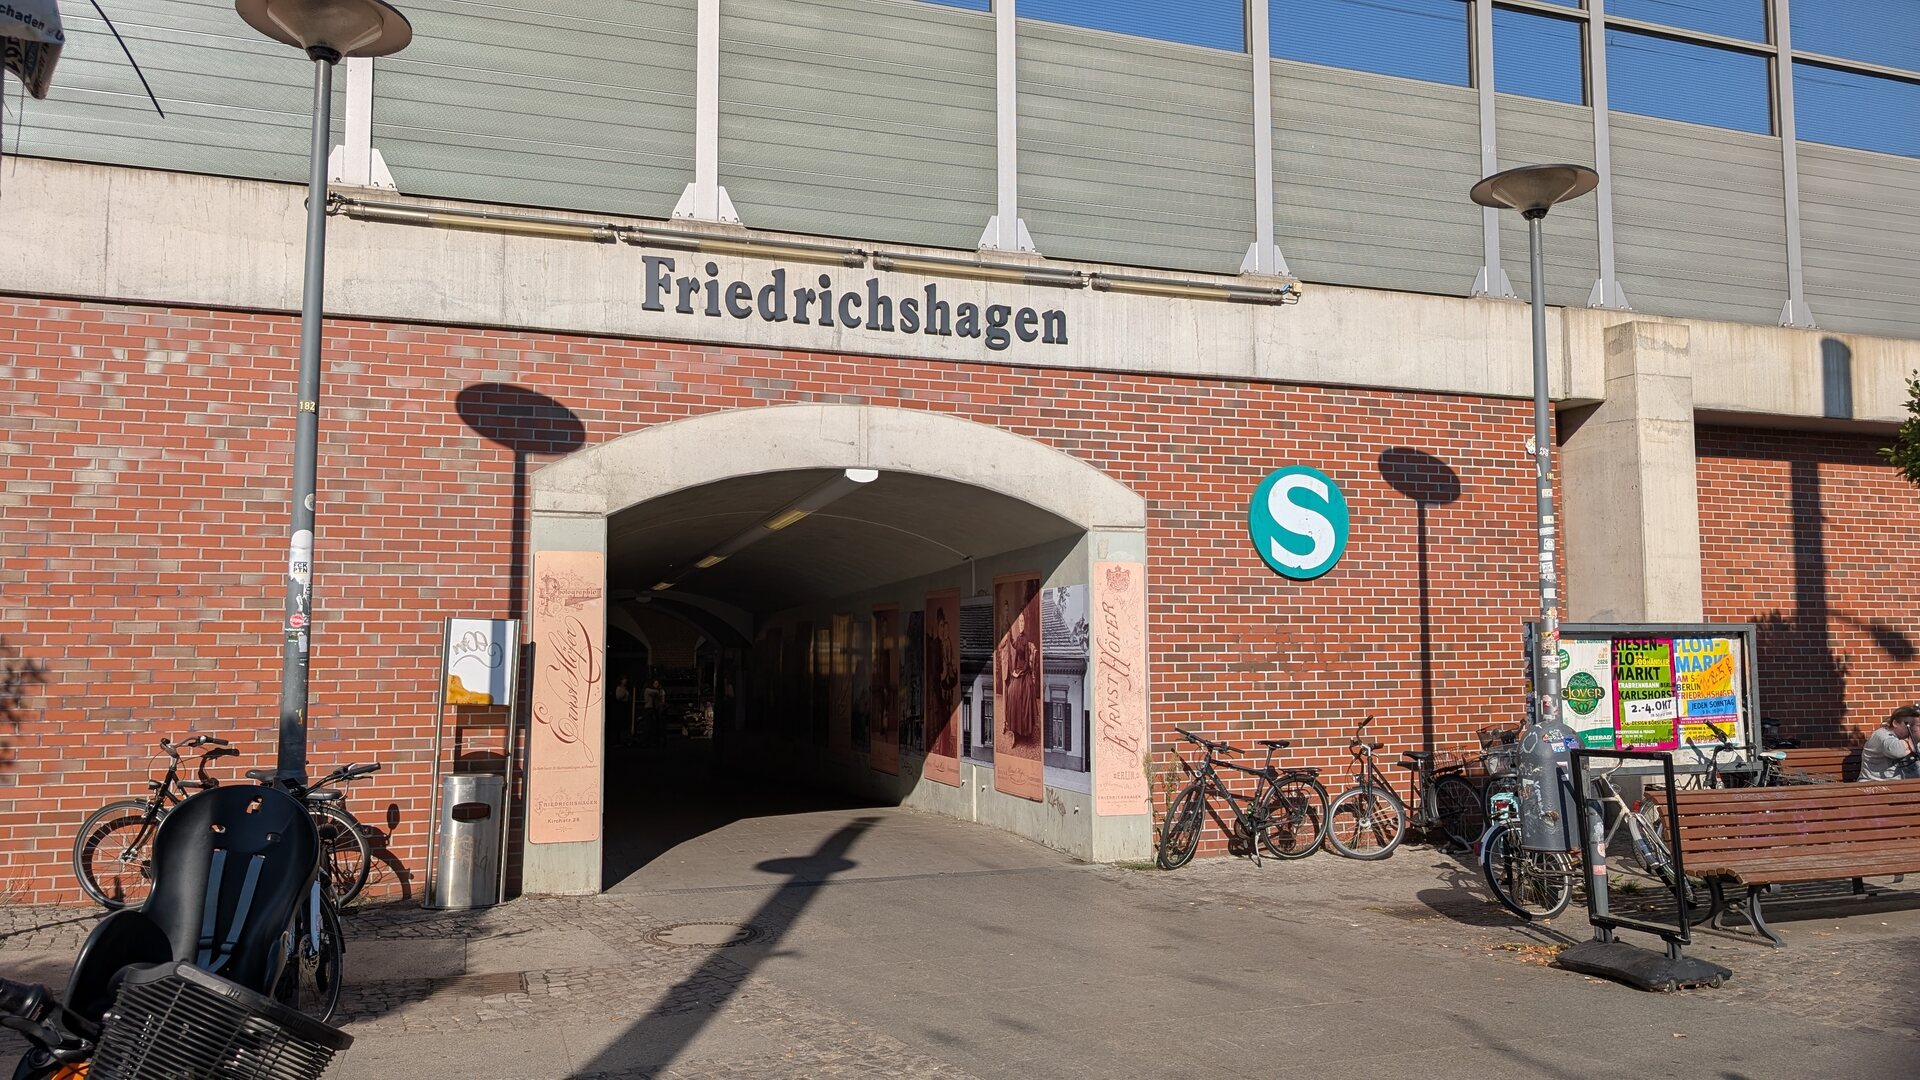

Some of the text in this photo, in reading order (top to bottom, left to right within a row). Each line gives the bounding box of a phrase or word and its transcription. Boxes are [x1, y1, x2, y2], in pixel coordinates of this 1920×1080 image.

[641, 255, 1069, 351] Friedrichshagen
[300, 401, 316, 411] 182
[1268, 474, 1335, 570] S
[1097, 601, 1131, 691] HÖFER
[1673, 639, 1720, 653] FLOH-
[1613, 667, 1661, 680] MARKT
[1676, 683, 1701, 691] BERLIN
[1618, 691, 1676, 700] KARLSHORST
[1677, 689, 1735, 699] FRIEDRICHSHAGEN
[1692, 698, 1735, 711] JEDEN SONNTAG
[533, 680, 579, 744] Ernst
[1098, 674, 1139, 767] ERNST
